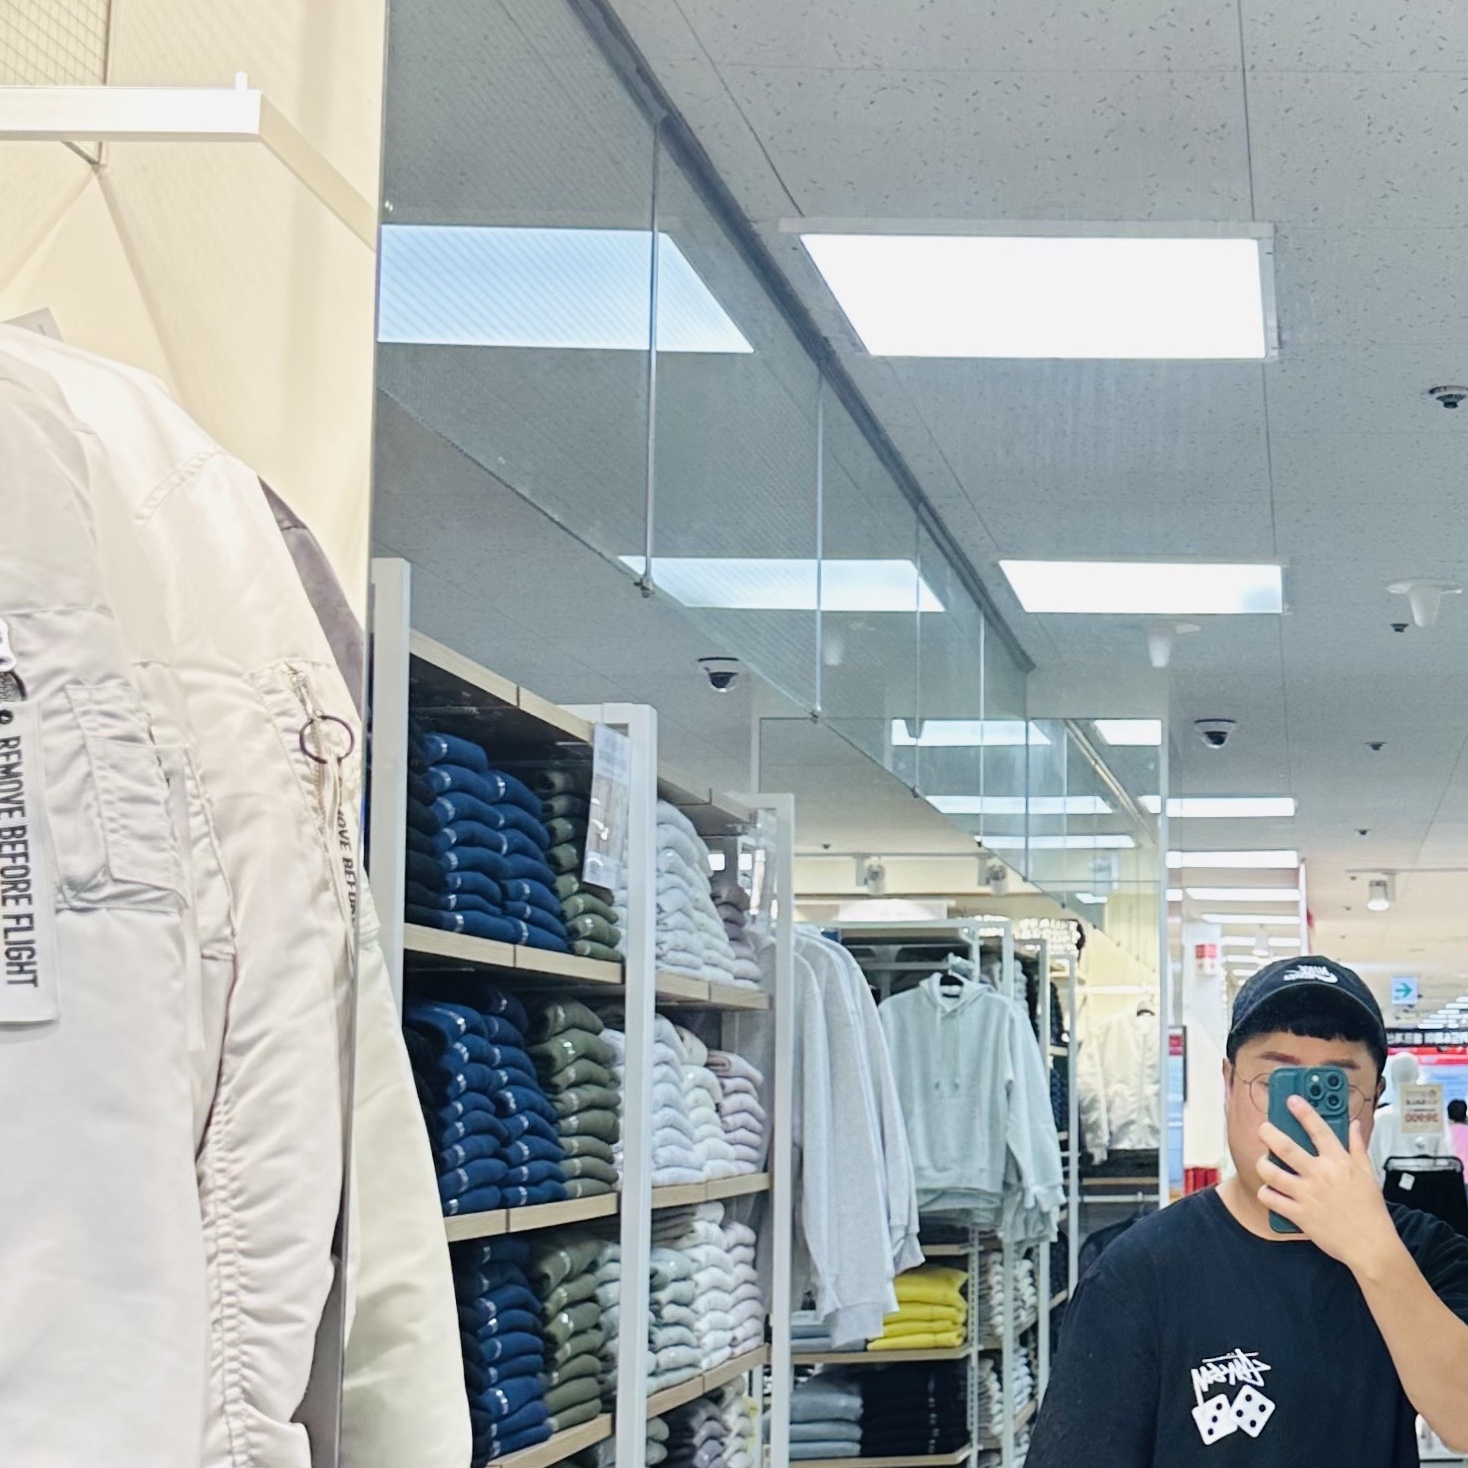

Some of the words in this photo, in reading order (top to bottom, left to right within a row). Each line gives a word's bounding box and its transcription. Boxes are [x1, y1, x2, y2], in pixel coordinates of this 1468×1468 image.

[0, 735, 26, 820] REMOVE
[0, 824, 34, 907] BEFORE
[2, 912, 39, 989] FLIGHT
